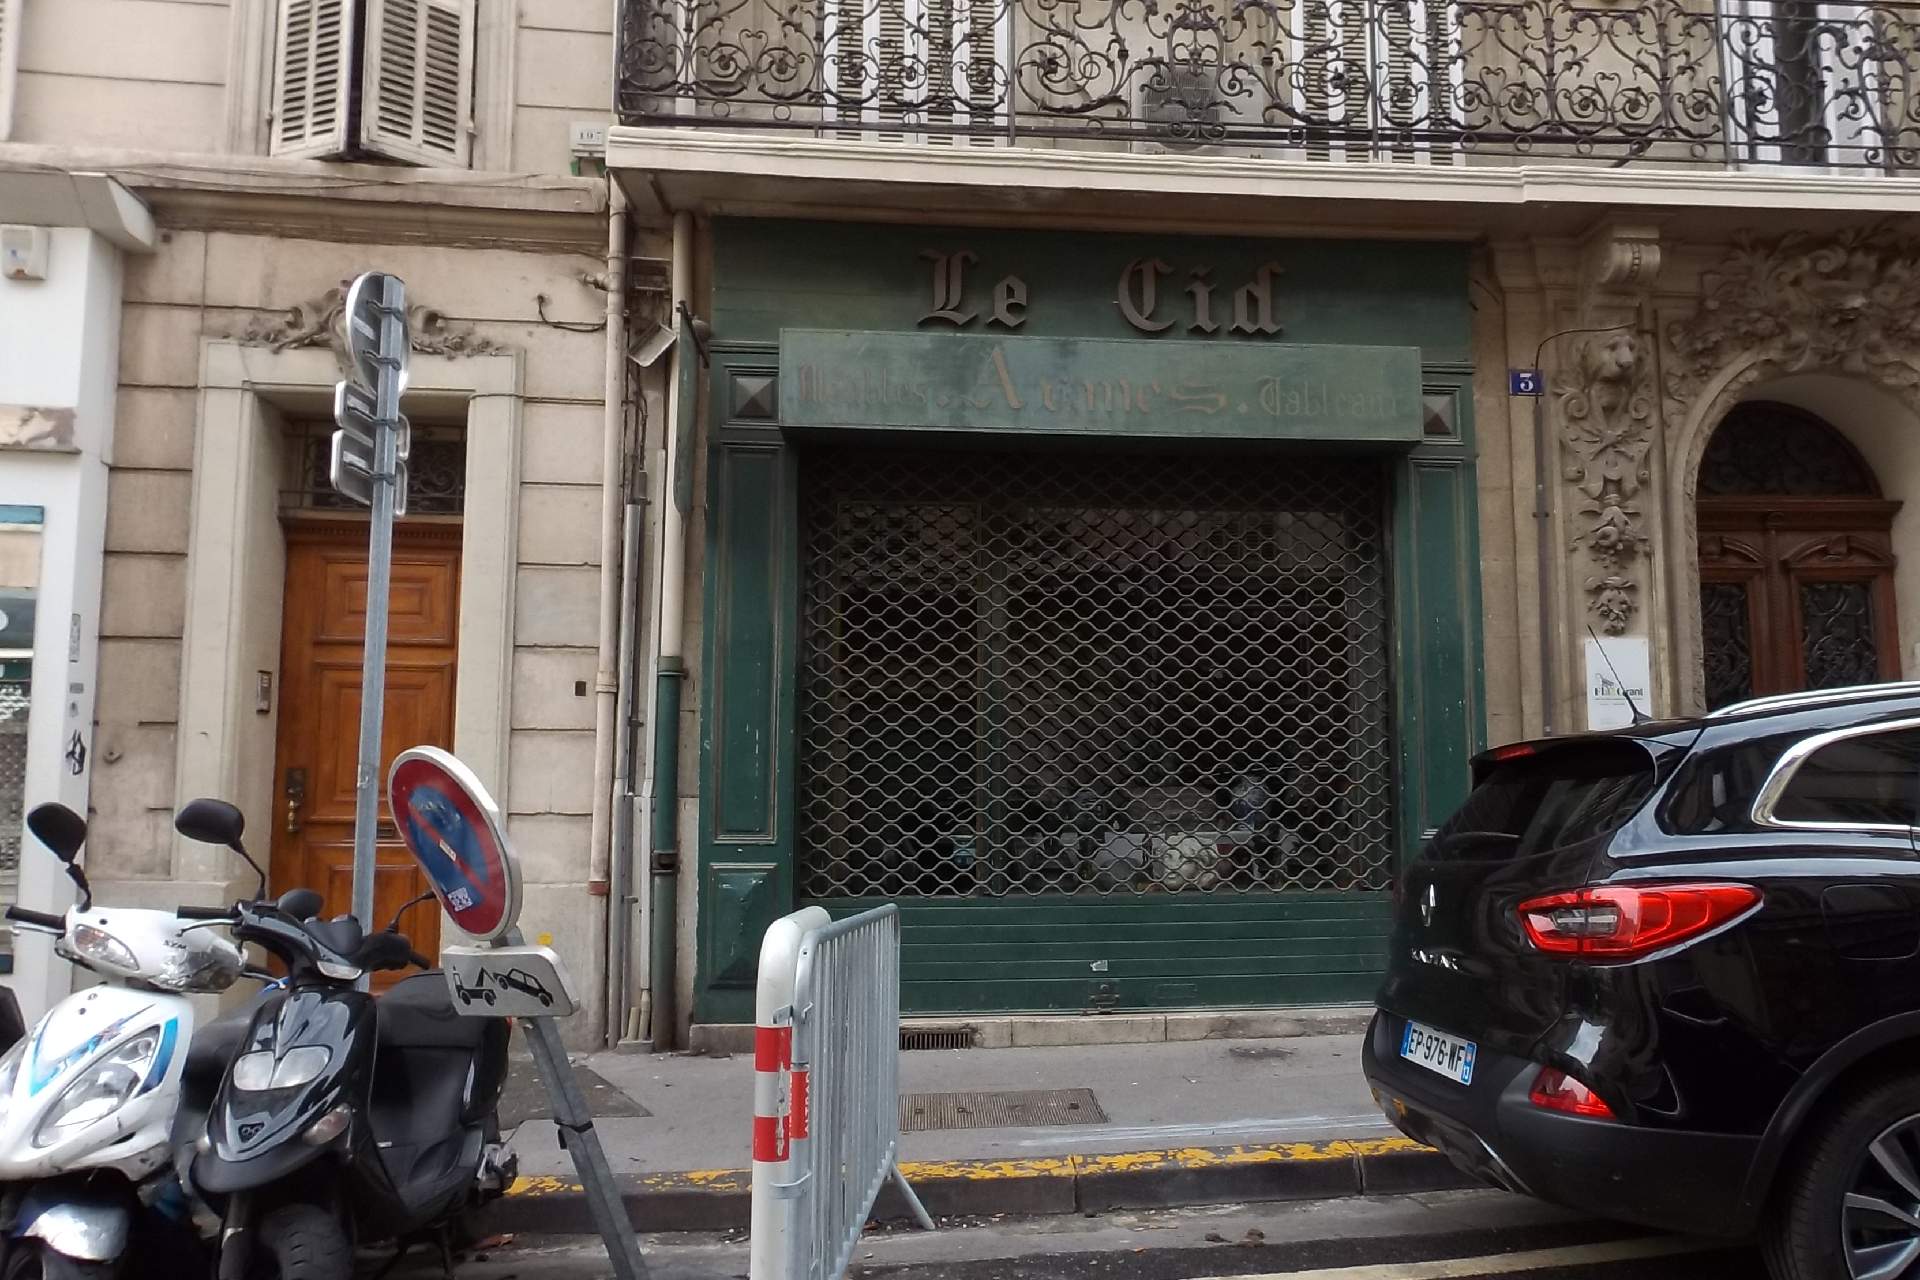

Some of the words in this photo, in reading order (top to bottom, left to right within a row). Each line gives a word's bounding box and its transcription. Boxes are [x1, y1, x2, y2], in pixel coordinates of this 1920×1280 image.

[917, 250, 1027, 328] Le
[1118, 257, 1284, 335] Cid
[1408, 1028, 1466, 1072] EP-976-WF
